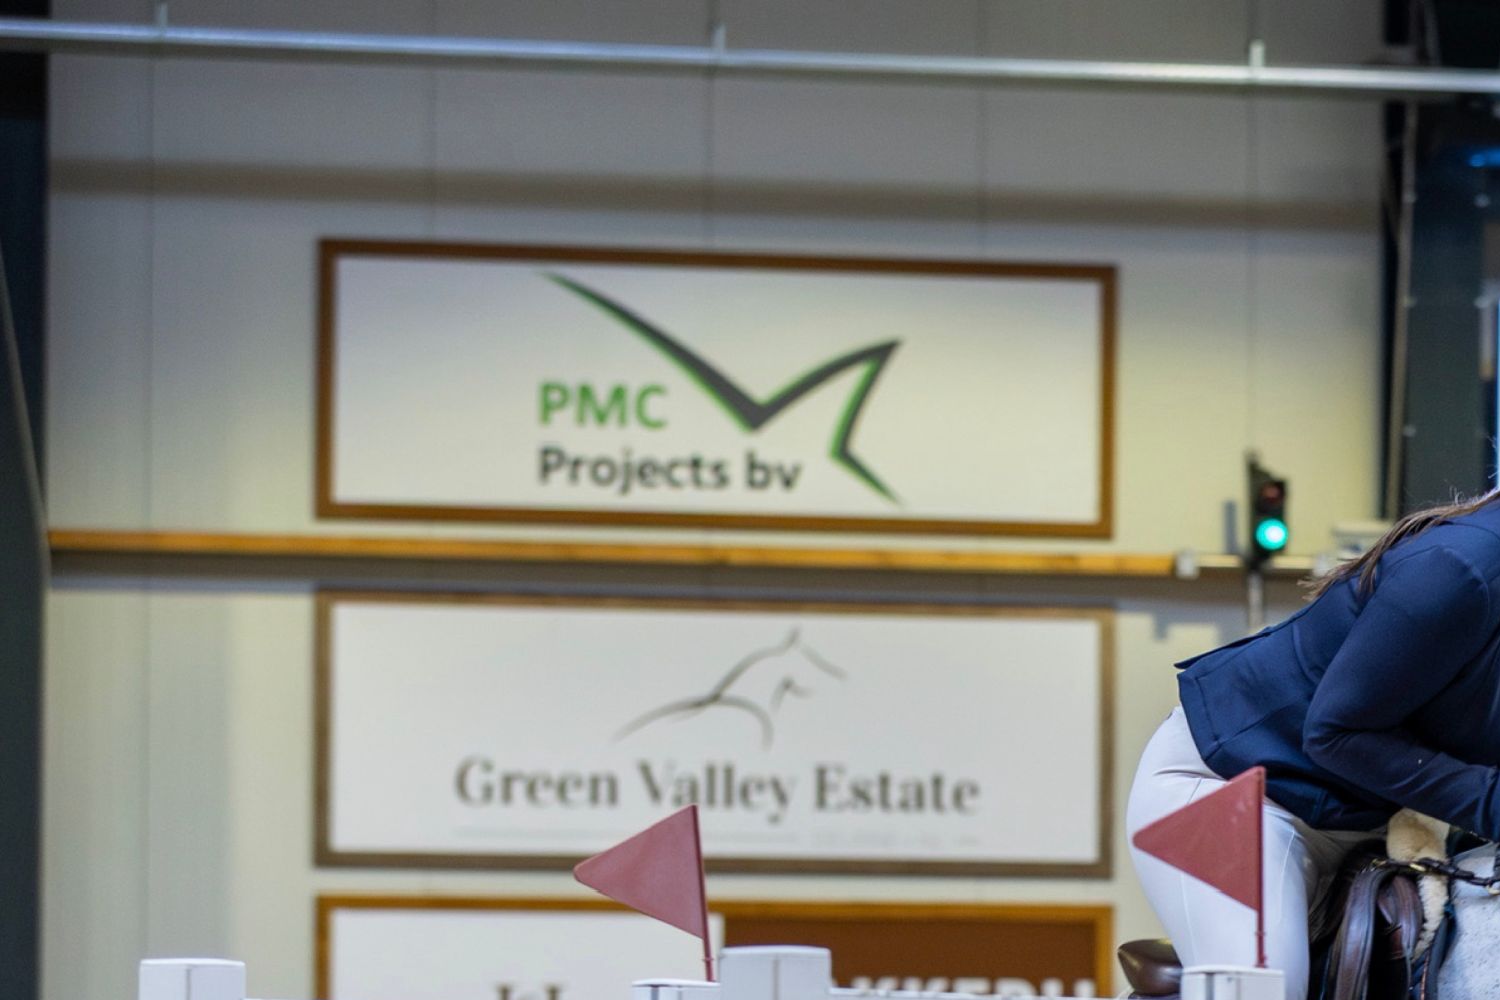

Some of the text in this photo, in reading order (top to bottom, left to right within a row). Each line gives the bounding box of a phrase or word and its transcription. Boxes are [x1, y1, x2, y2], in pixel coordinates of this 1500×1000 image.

[539, 382, 667, 429] PMC
[538, 446, 803, 494] Projects bv
[455, 756, 980, 826] Green Valley Estate
